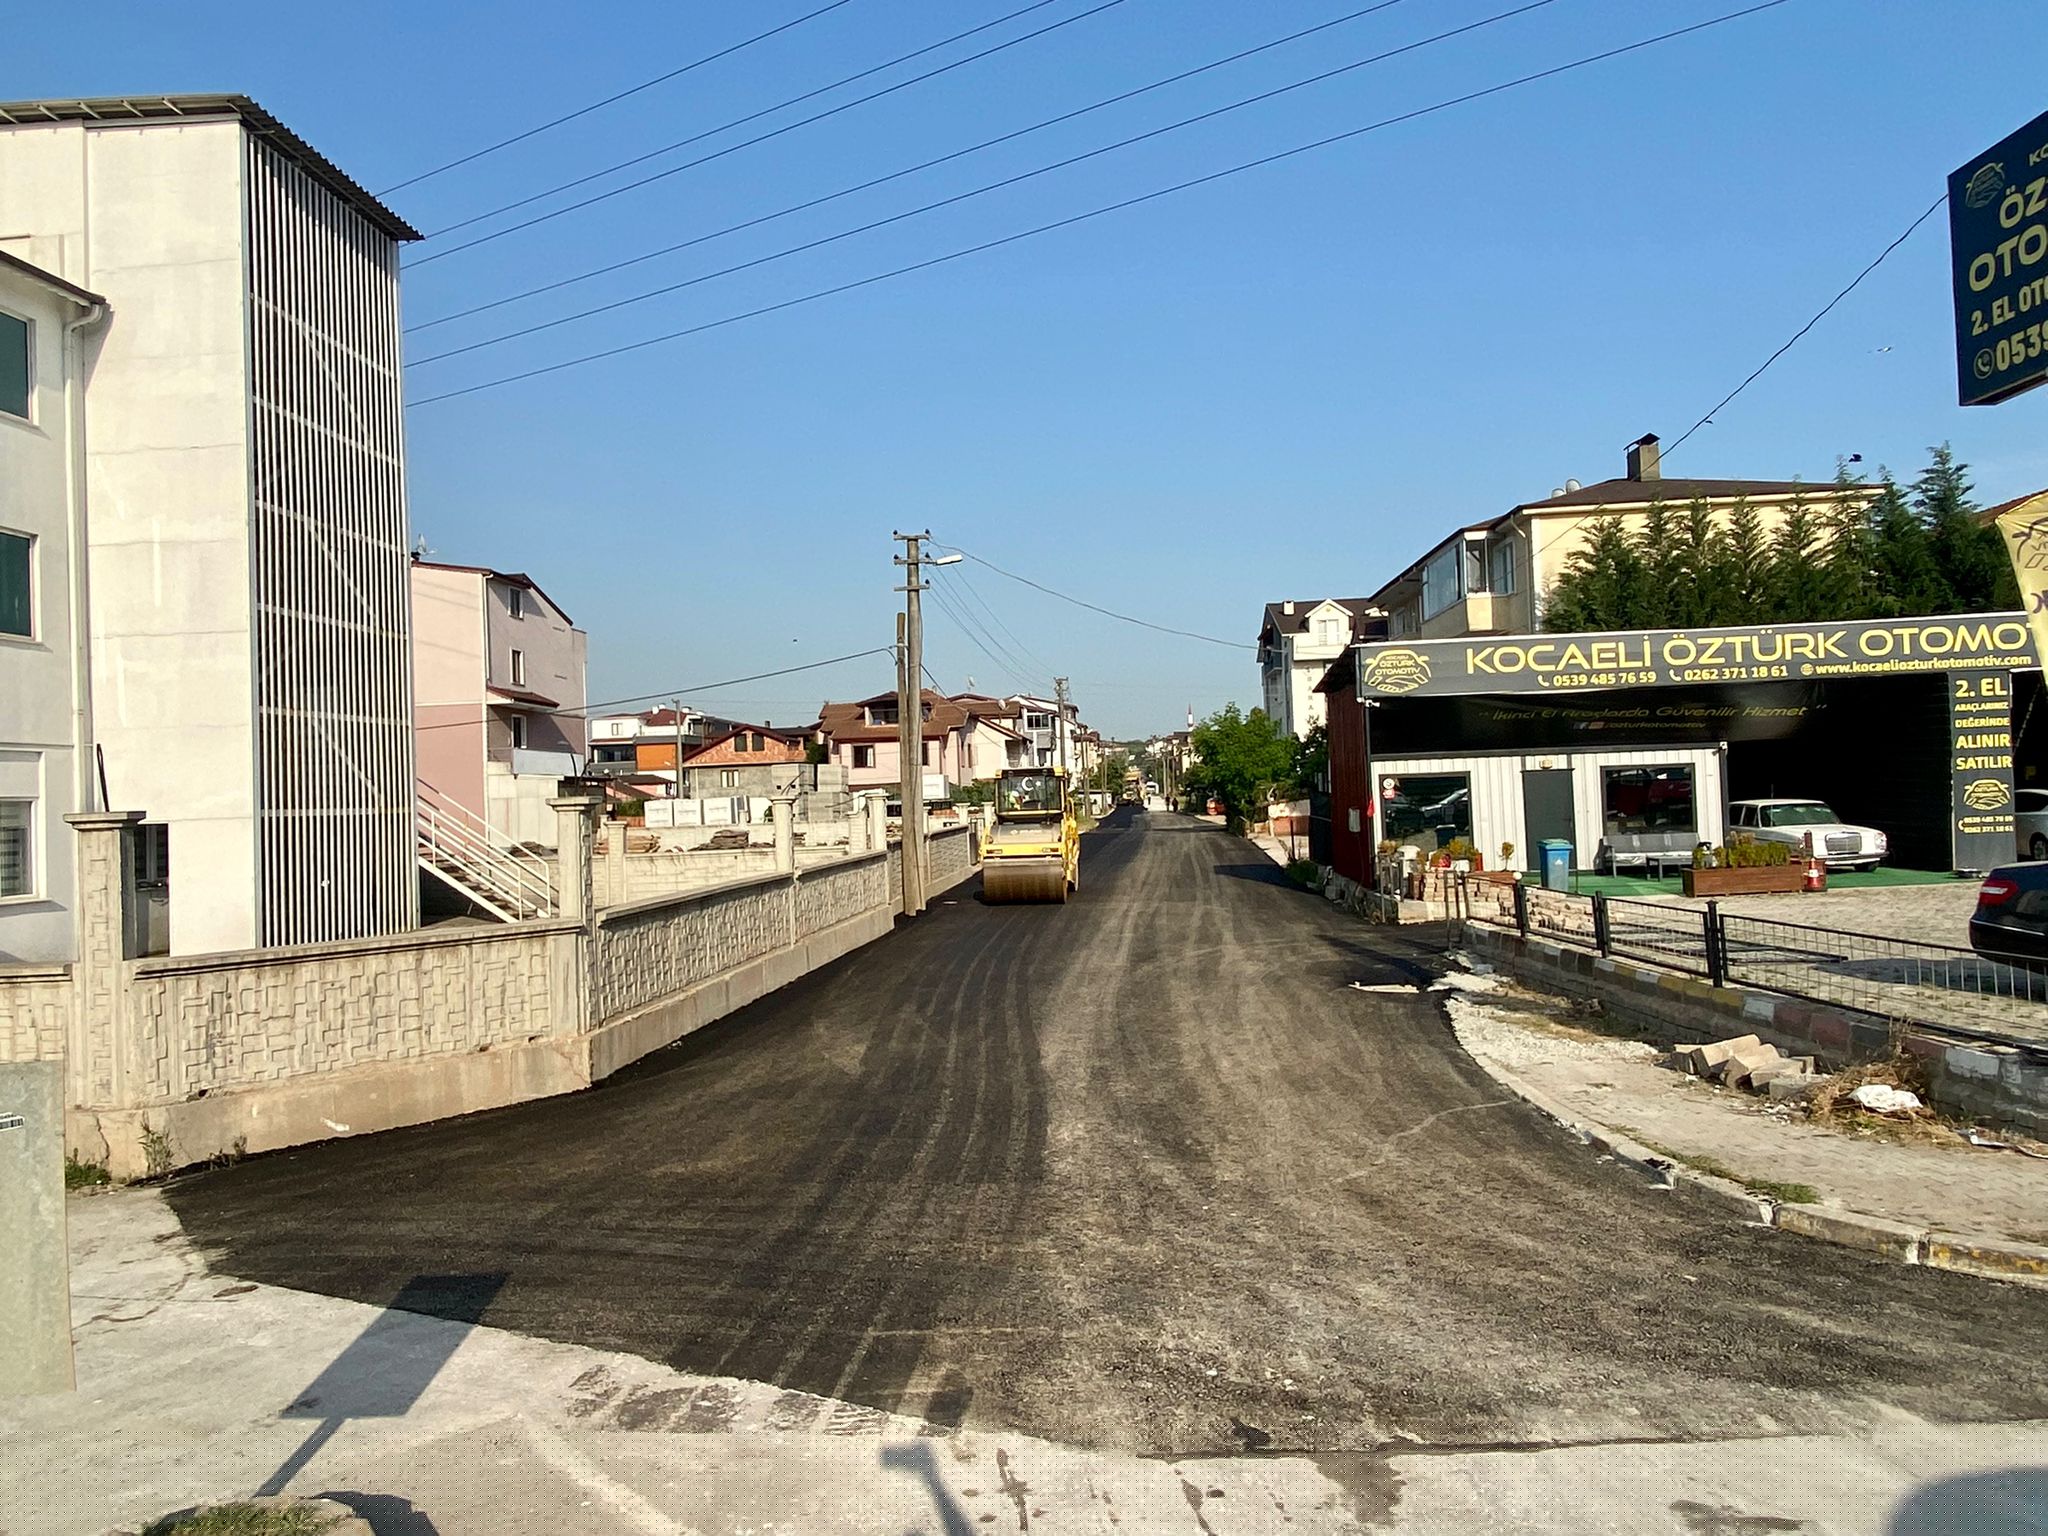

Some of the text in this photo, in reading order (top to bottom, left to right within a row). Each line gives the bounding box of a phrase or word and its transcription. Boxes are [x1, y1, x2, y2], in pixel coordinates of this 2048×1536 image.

[1971, 310, 1989, 336] 2.
[1992, 295, 2016, 326] EL
[1466, 622, 2033, 674] KOCAELİ ÖZTÜRK OTOMO
[1815, 654, 2032, 675] www.kocaeliozturkotomotiv.com
[1552, 671, 1657, 687] 0539 485 76 59
[1684, 665, 1788, 681] 0262 371 18 61
[1955, 678, 2008, 698] 2. EL
[1742, 706, 1808, 717] Hizmet
[1956, 733, 2011, 749] ALINIR
[1956, 755, 2013, 770] SATILIR
